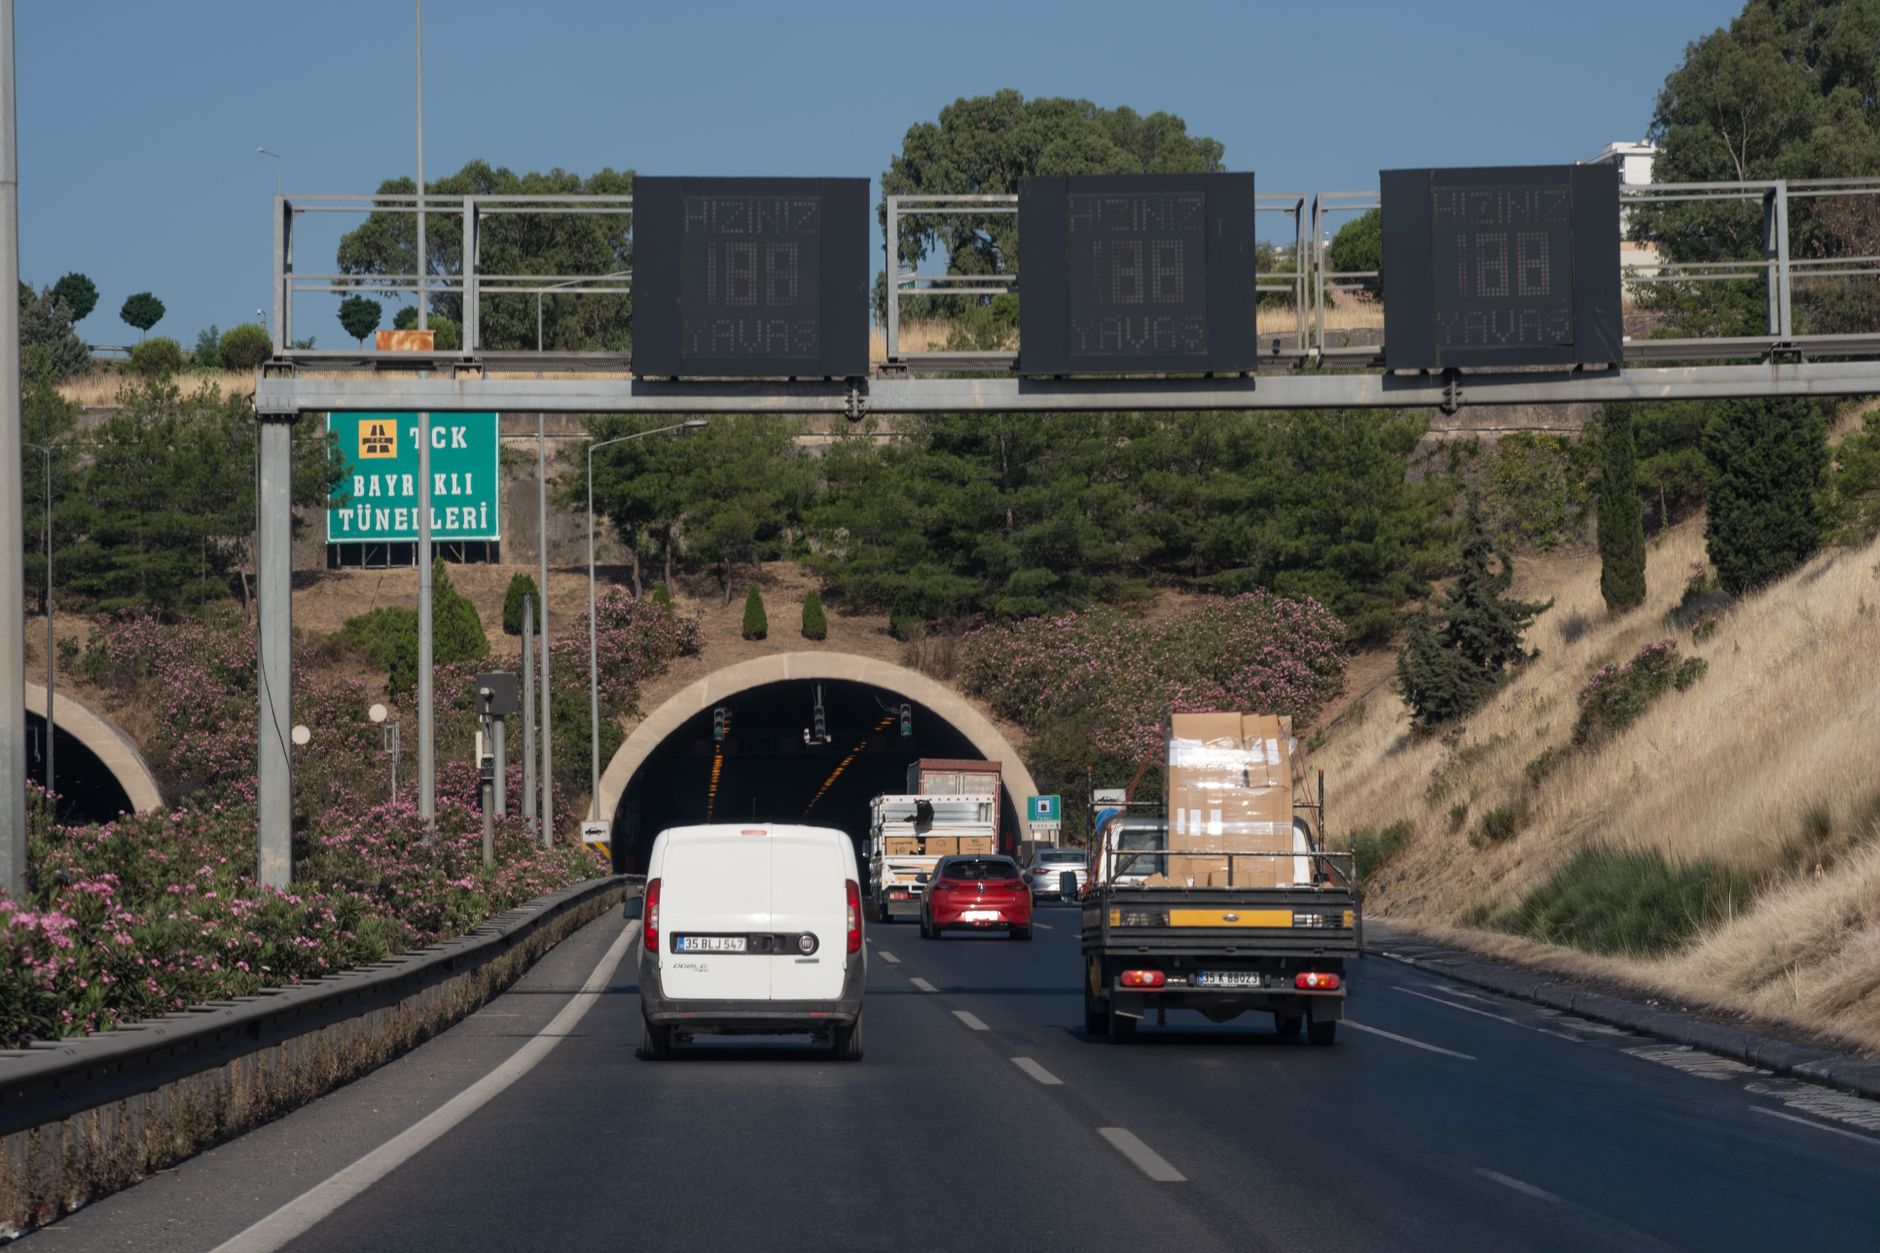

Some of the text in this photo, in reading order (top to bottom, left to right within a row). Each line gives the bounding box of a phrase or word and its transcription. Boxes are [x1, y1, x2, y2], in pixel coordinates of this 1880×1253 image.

[685, 201, 817, 234] HIZINIZ
[353, 472, 473, 497] BAYRKLI
[685, 938, 699, 949] 35
[701, 938, 722, 950] BLJ
[724, 939, 744, 950] 547
[1204, 972, 1258, 983] 35 K 88023
